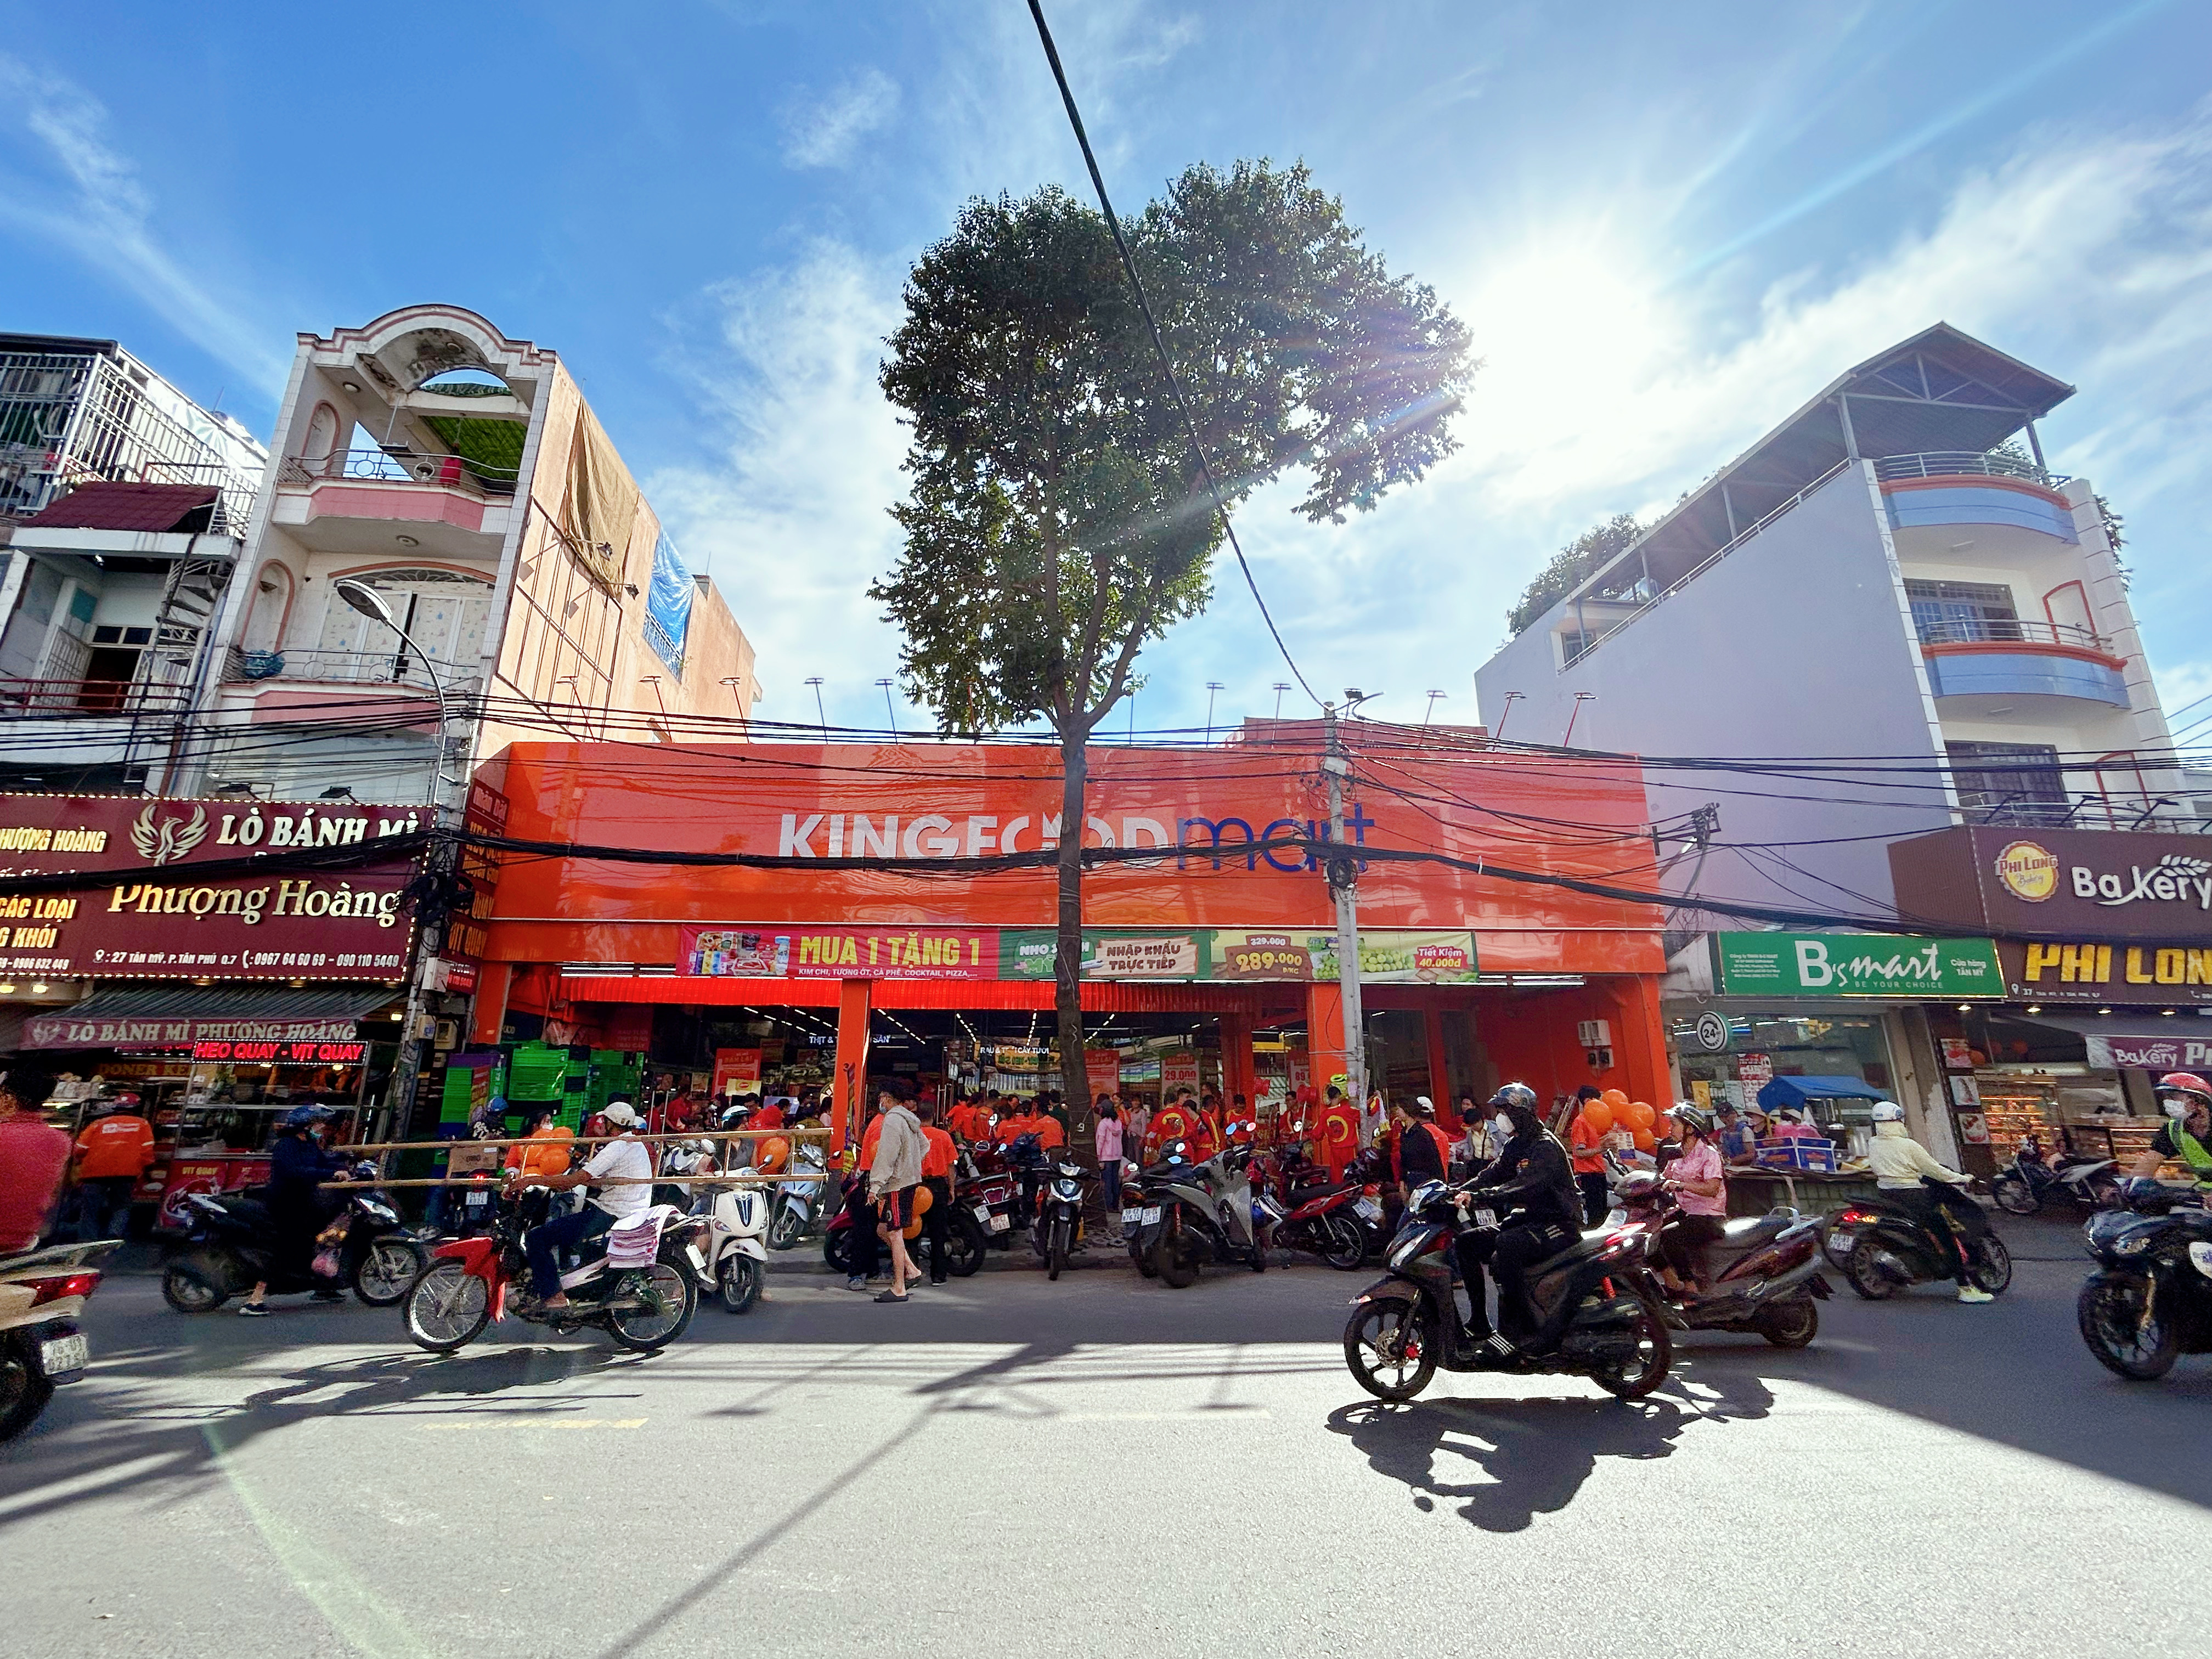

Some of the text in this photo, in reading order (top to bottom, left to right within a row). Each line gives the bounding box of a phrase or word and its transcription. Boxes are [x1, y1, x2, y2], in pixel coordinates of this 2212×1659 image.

[216, 807, 264, 845] LÒ
[268, 808, 368, 847] BÁNH
[0, 826, 107, 854] HƯỢNG HOÀNG
[2072, 865, 2212, 910] Bakery
[33, 899, 77, 923] LOẠI
[107, 879, 403, 928] Phượng Hoàng
[12, 923, 58, 948] KHÓI
[1250, 938, 1286, 946] 329.000
[110, 952, 127, 963] 27
[128, 952, 146, 963] TÂN
[196, 953, 217, 964] PHÚ
[799, 932, 980, 969] MUA 1 TẶNG 1
[1019, 944, 1049, 956] NHO
[1107, 940, 1181, 959] NHẬP KHẨU
[1419, 946, 1462, 957] Tiết Kiệm
[281, 953, 296, 966] 64
[297, 953, 311, 966] 60
[312, 953, 326, 967] 69
[336, 953, 356, 967] 090
[357, 954, 372, 967] 110
[374, 955, 399, 967] 5449
[1023, 954, 1054, 974] MỸ
[1109, 956, 1176, 973] TRỰC TIẾP
[1235, 951, 1303, 972] 289.000
[1419, 958, 1462, 968] 40.000đ
[1849, 943, 1942, 981] mart
[2025, 944, 2212, 985] PHI LON
[860, 968, 872, 977] ỚT,
[873, 968, 884, 977] CÀ
[886, 968, 903, 977] PHÊ,
[905, 969, 944, 978] COCKTAIL,
[67, 1020, 95, 1041] LÒ
[99, 1020, 161, 1042] BÁNH
[165, 1019, 191, 1041] MÌ
[284, 1019, 357, 1040] HOÀNG
[809, 1036, 827, 1045] THỊT
[1703, 1028, 1716, 1038] 24
[194, 1042, 232, 1058] HEO
[234, 1043, 280, 1059] QUAY
[291, 1043, 318, 1062] VỊT
[318, 1045, 363, 1060] QUAY
[1018, 1046, 1030, 1054] CÂY
[2115, 1048, 2177, 1068] Bakery
